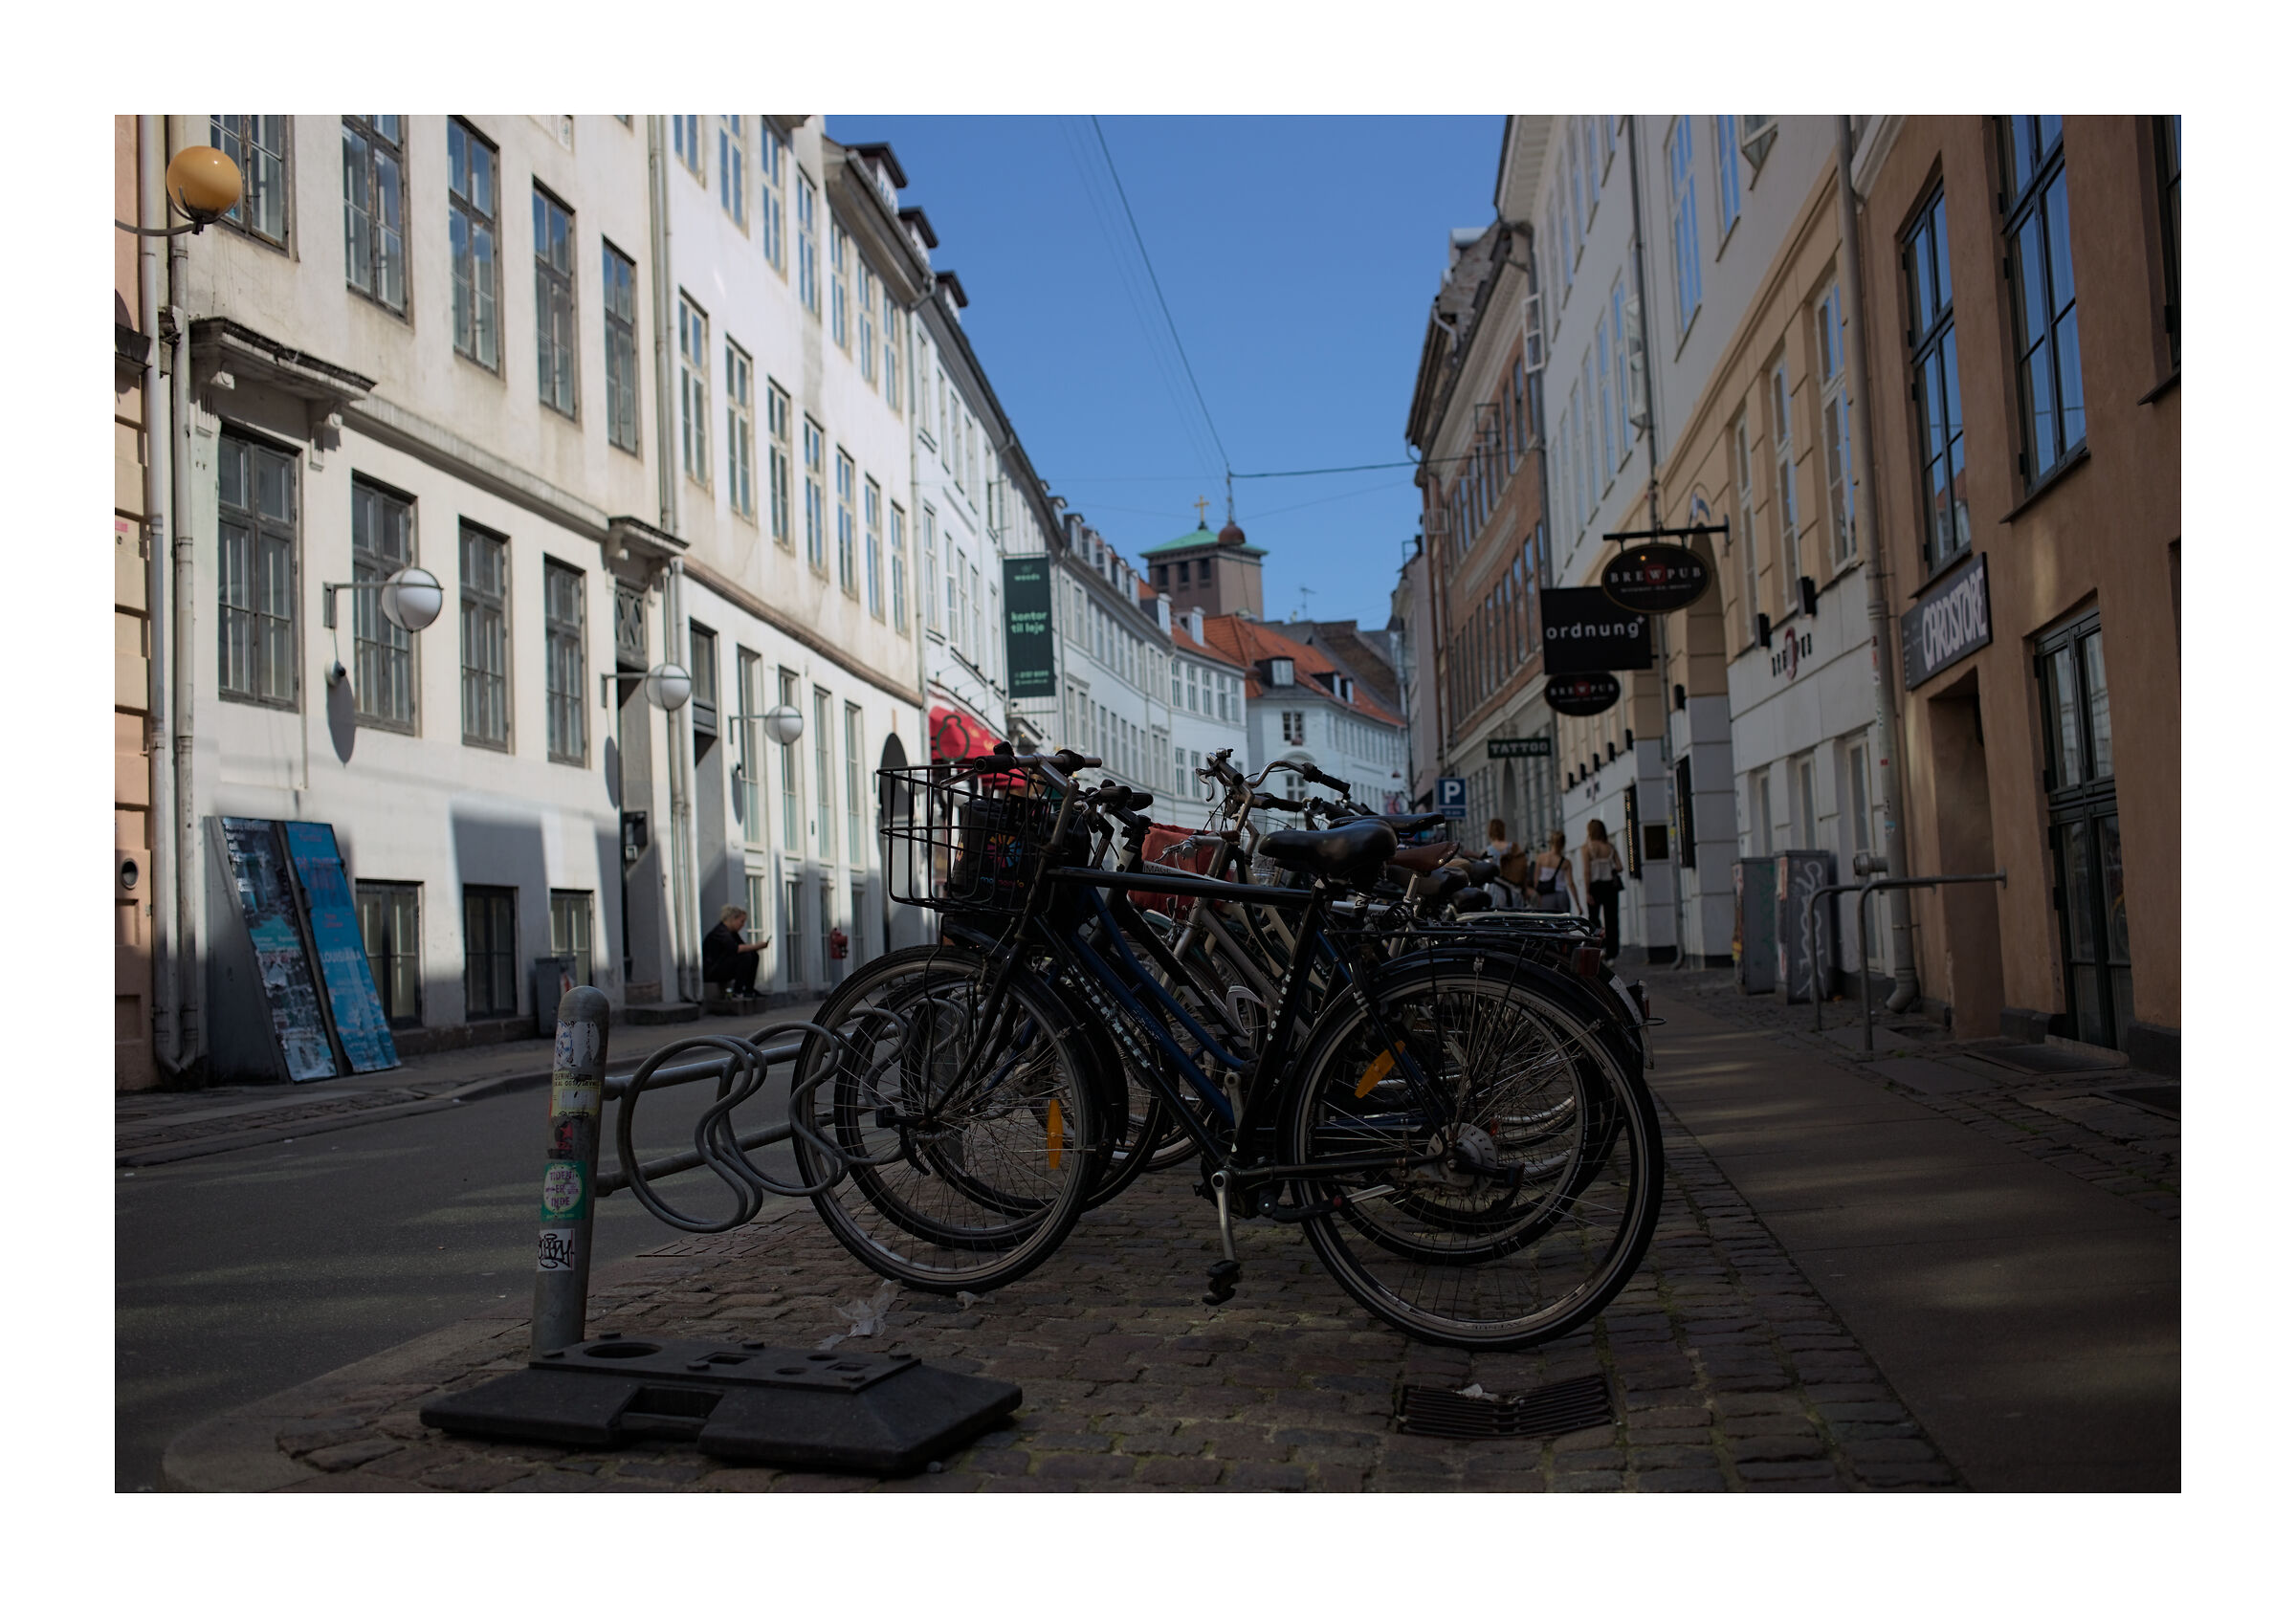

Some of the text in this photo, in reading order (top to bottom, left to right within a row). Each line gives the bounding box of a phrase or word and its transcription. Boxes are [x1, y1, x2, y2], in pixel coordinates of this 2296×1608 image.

[1609, 566, 1702, 584] BREWPUB
[1011, 611, 1048, 623] kontor
[1922, 566, 1987, 672] CARDSTORE
[1011, 623, 1024, 633] til
[1550, 682, 1615, 696] BREWPUB
[1490, 741, 1549, 755] TATTOO
[1444, 781, 1461, 804] P
